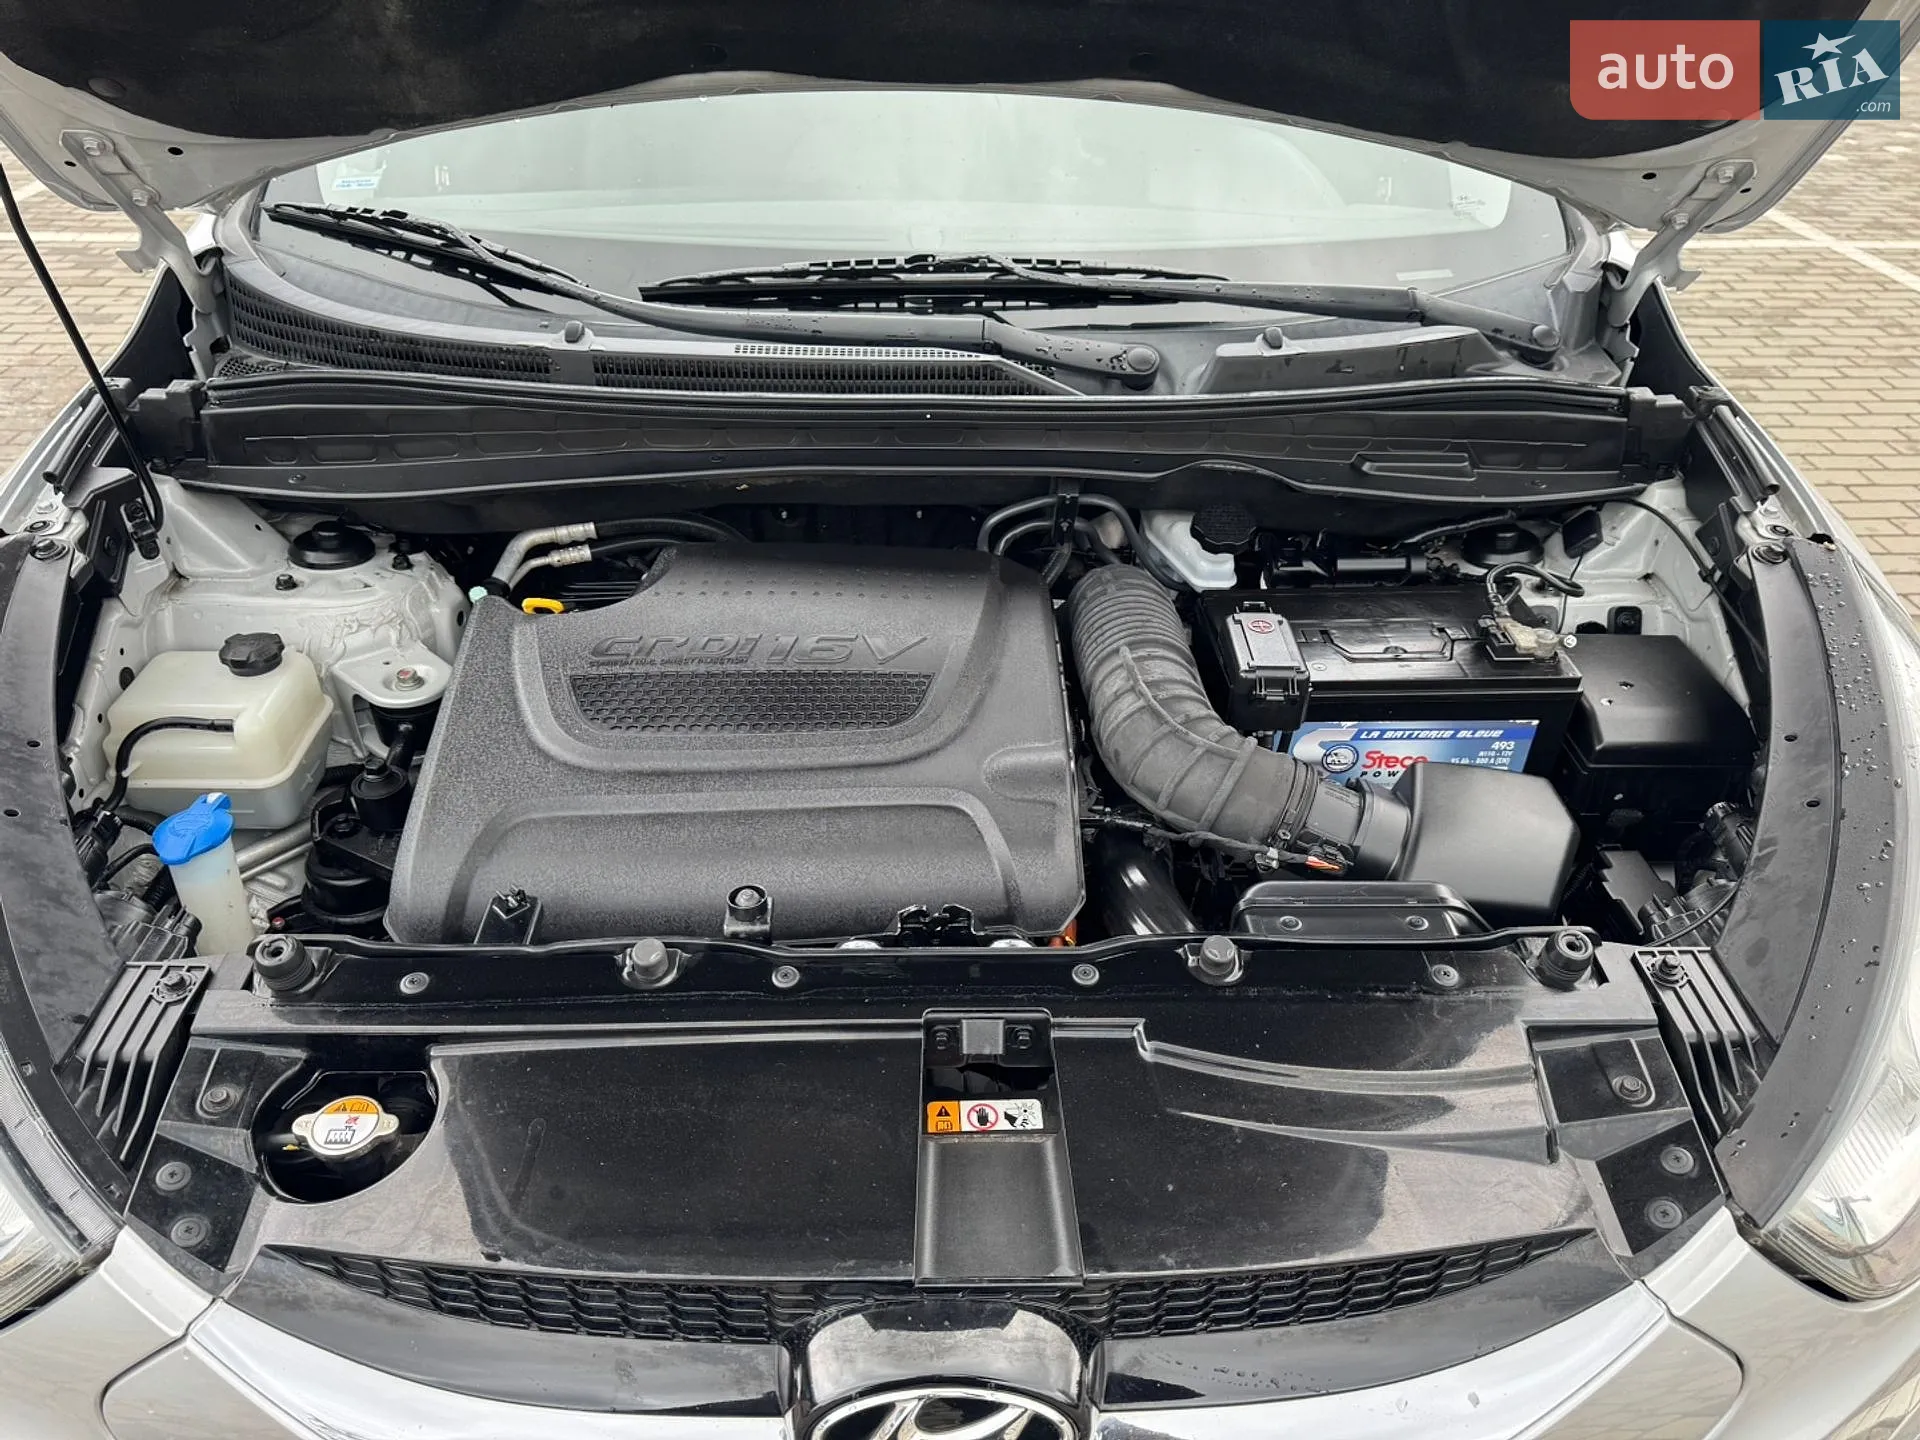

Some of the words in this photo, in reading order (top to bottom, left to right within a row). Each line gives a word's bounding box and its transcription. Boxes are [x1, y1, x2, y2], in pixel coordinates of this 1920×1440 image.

[766, 634, 930, 665] 16V
[1360, 731, 1379, 739] LA
[1383, 729, 1455, 739] BATTERIE
[1490, 741, 1516, 750] 493
